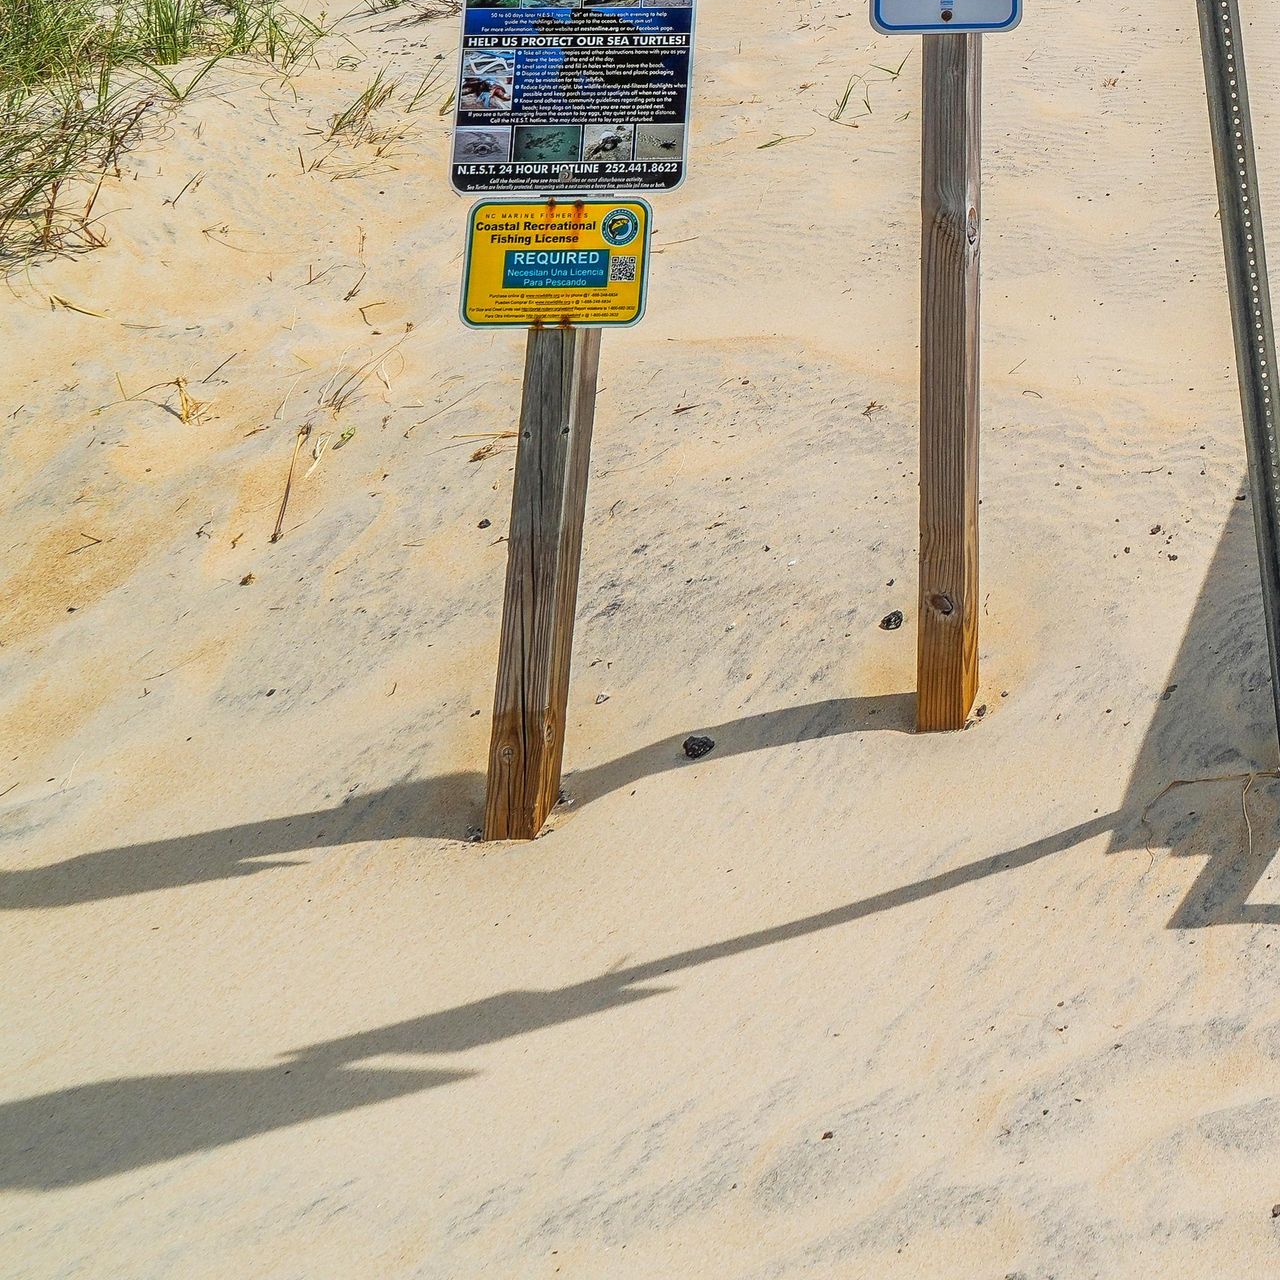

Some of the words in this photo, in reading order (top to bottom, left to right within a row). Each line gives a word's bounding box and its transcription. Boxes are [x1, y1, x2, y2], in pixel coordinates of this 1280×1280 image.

[468, 37, 498, 45] HELP
[501, 37, 517, 45] US
[521, 37, 573, 45] PROTECT
[577, 36, 603, 45] OUR
[607, 36, 629, 44] SEA
[632, 36, 685, 44] TURTLES!
[457, 165, 496, 174] N.E.S.T.
[498, 165, 512, 174] 24
[515, 165, 549, 173] HOUR
[551, 164, 599, 173] HOTLINE
[605, 163, 677, 172] 252.441.8622
[475, 221, 519, 230] Coastal
[523, 221, 596, 230] Recreational
[490, 234, 531, 245] Fishing
[534, 234, 579, 242] License
[513, 252, 599, 264] REQUIRED
